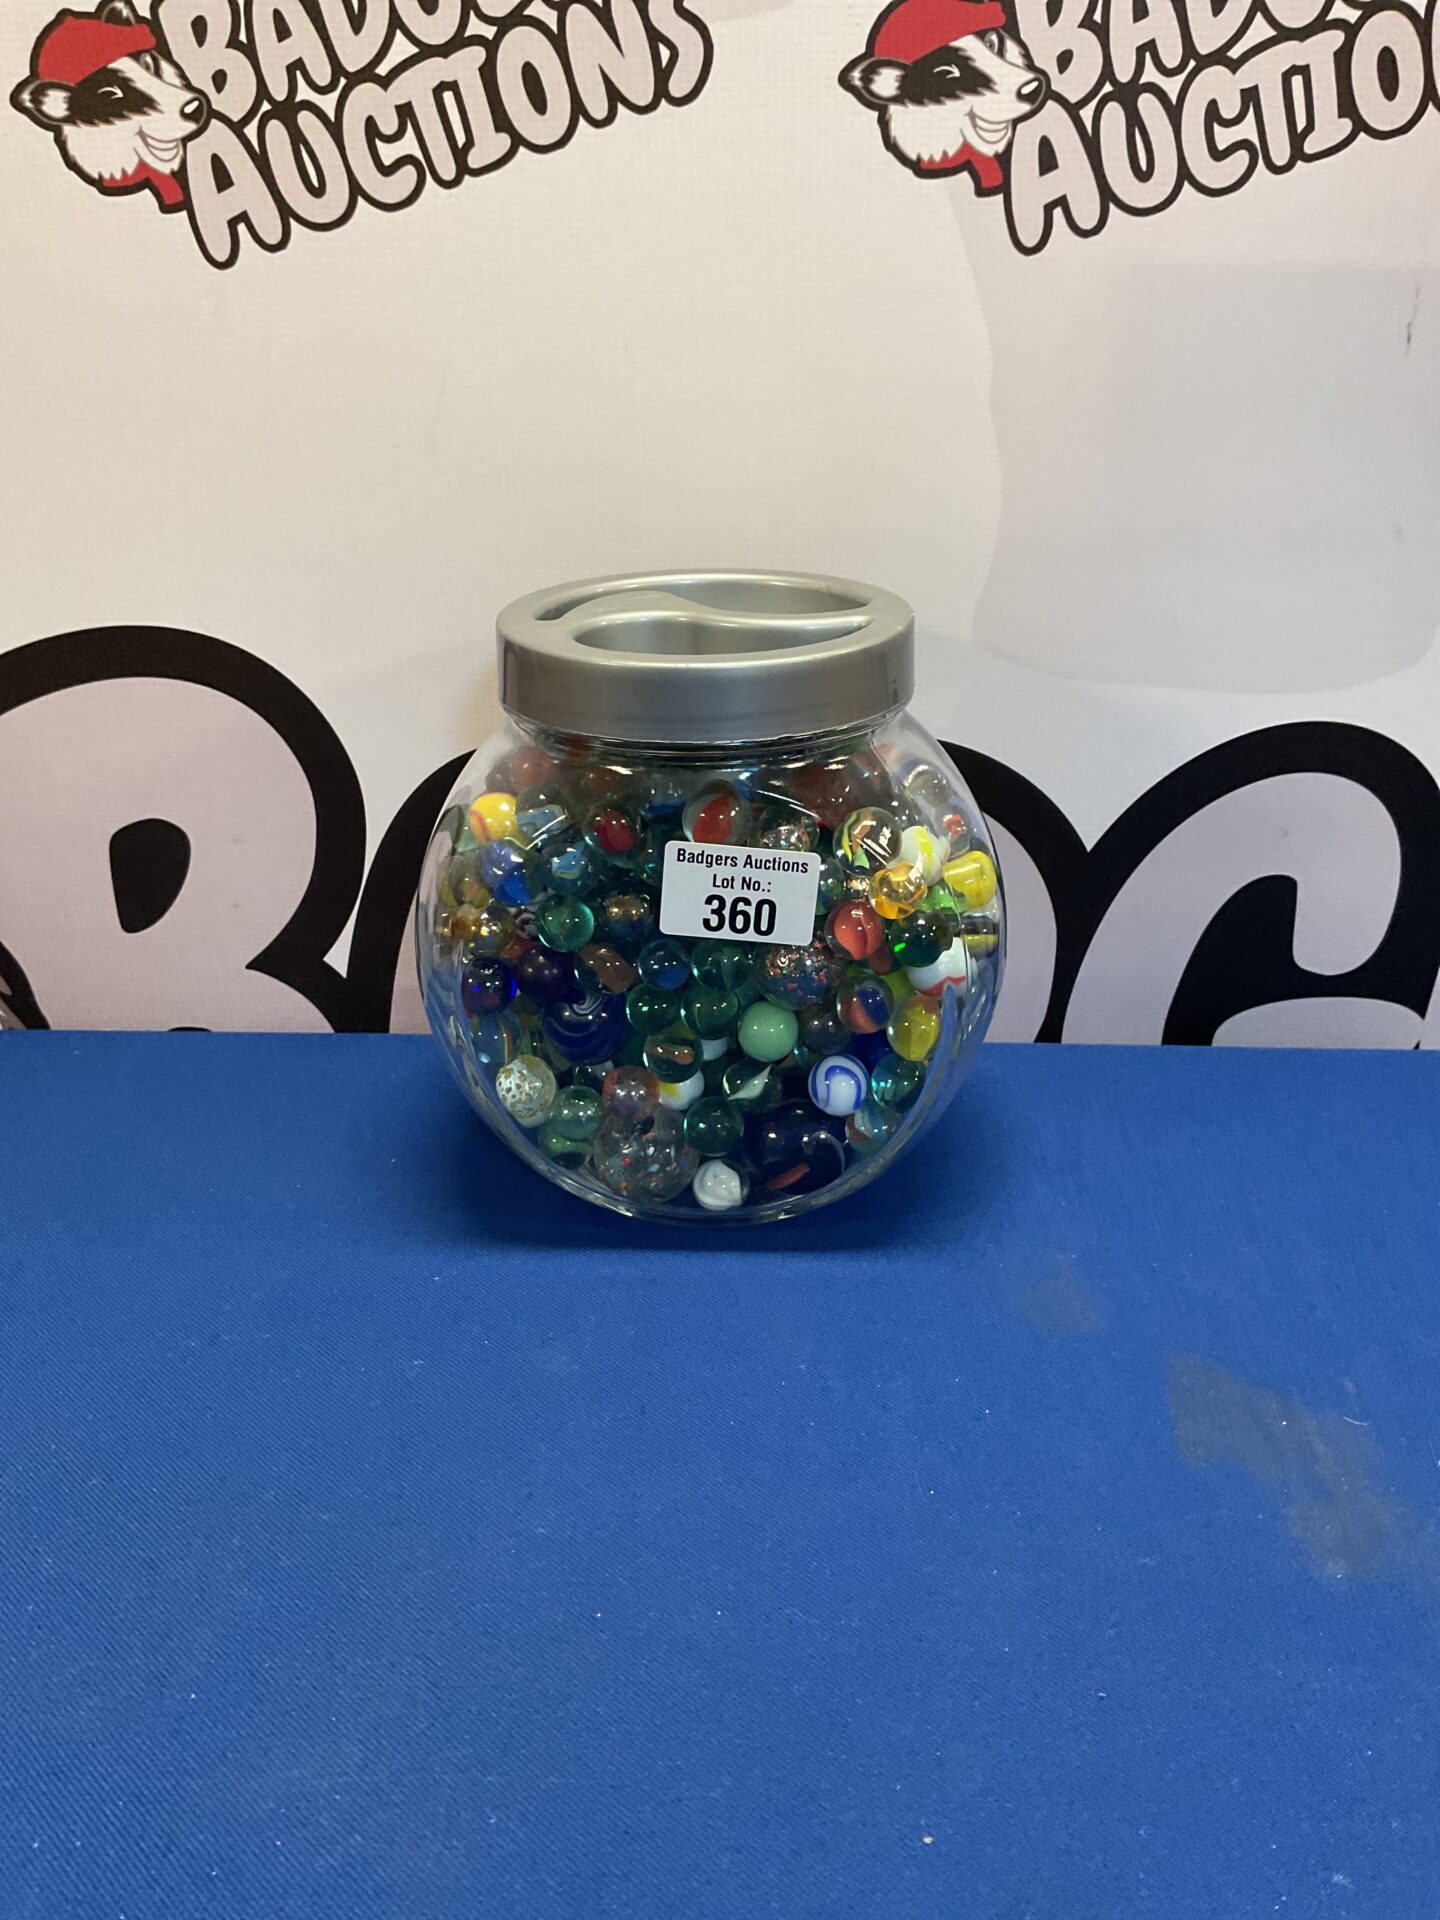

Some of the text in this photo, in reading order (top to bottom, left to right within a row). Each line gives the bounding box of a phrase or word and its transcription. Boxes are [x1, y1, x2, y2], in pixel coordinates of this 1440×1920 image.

[186, 0, 714, 270] AUCTIONS
[1003, 2, 1440, 256] AUCTIO
[676, 848, 809, 874] Badgers Auctions
[712, 873, 772, 893] Lot No.:
[702, 894, 777, 936] 360
